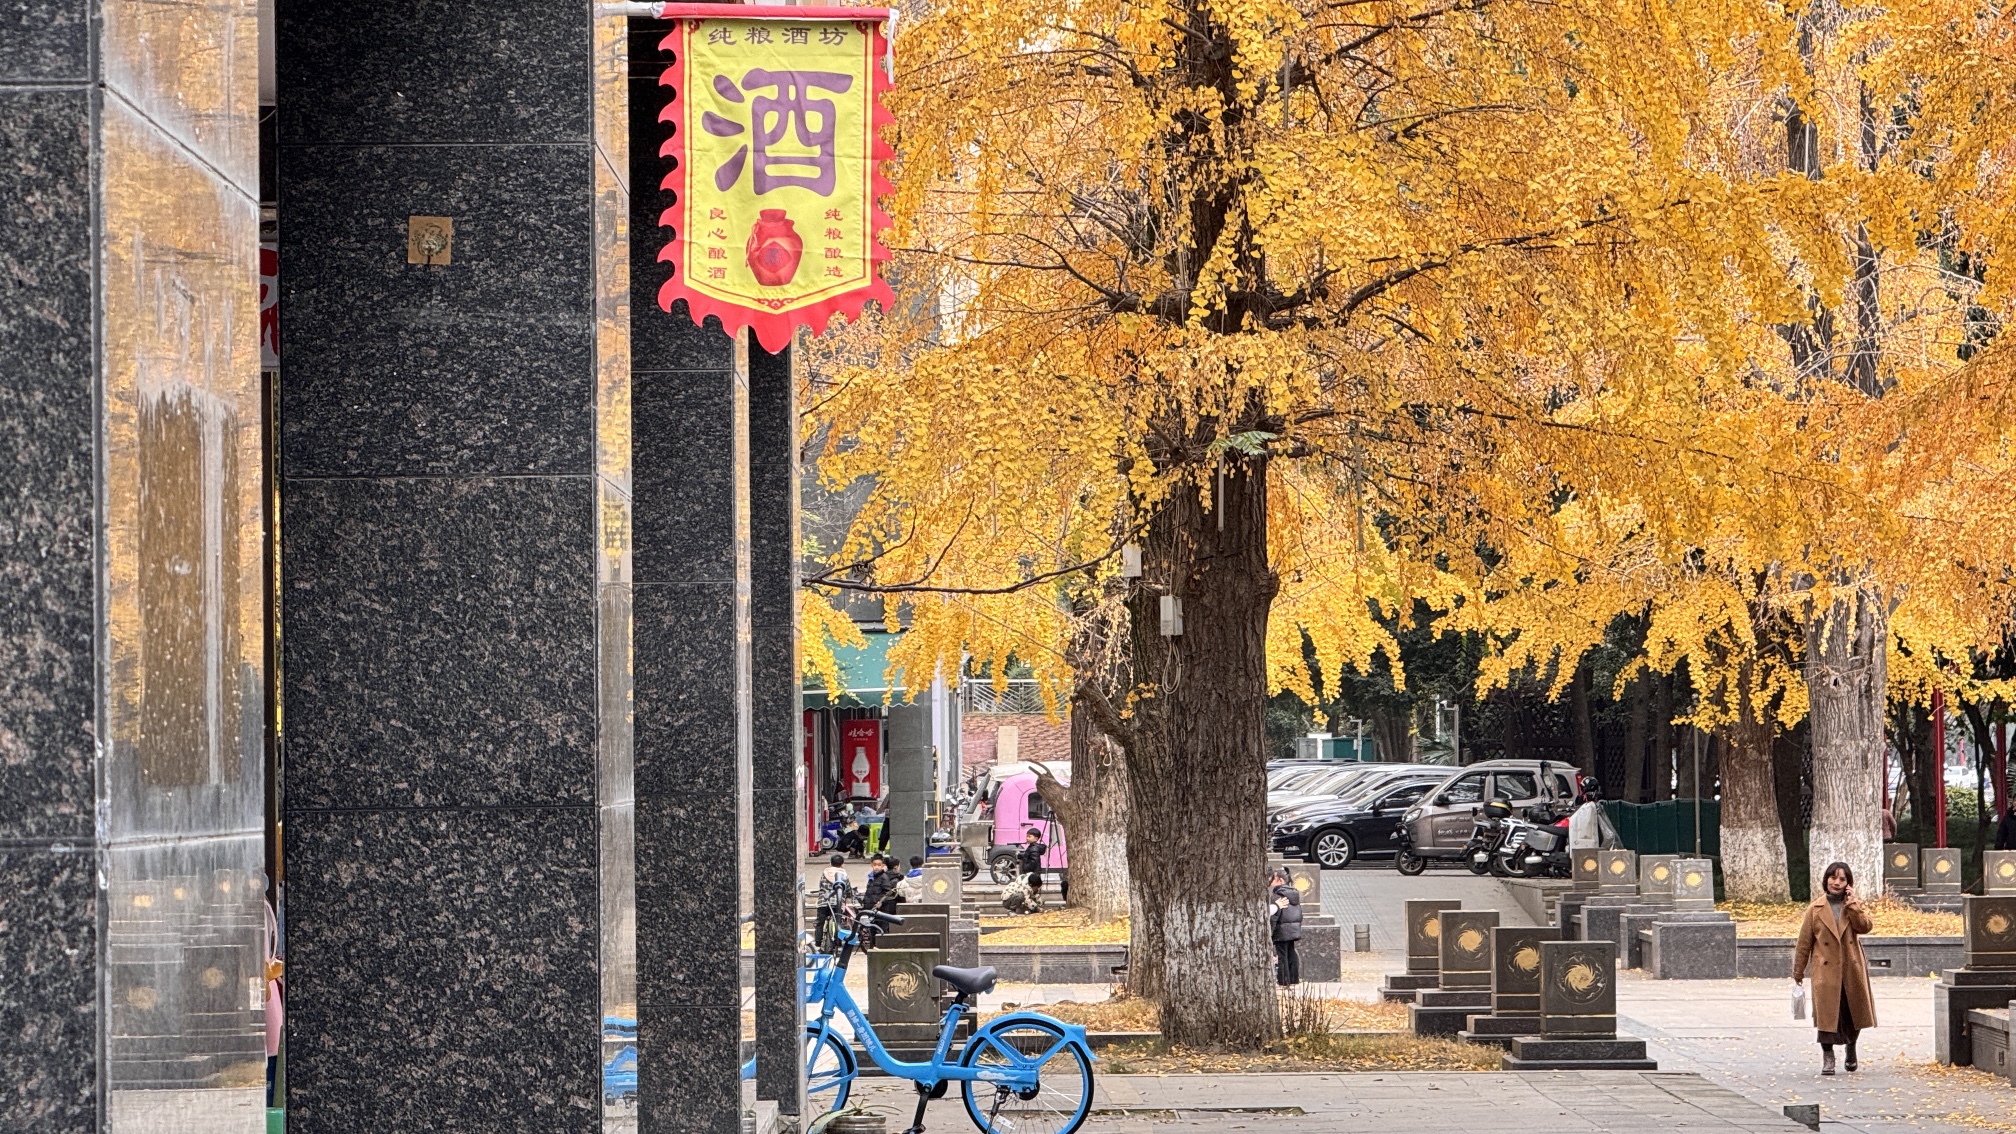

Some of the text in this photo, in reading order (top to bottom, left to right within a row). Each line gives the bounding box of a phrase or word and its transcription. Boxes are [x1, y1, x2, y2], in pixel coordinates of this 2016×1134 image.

[707, 26, 849, 46] 纯粮酒坊
[702, 67, 854, 197] 酒
[708, 207, 728, 279] 良心酿酒
[824, 207, 844, 278] 纯粮酿造
[848, 728, 874, 737] 娃哈哈
